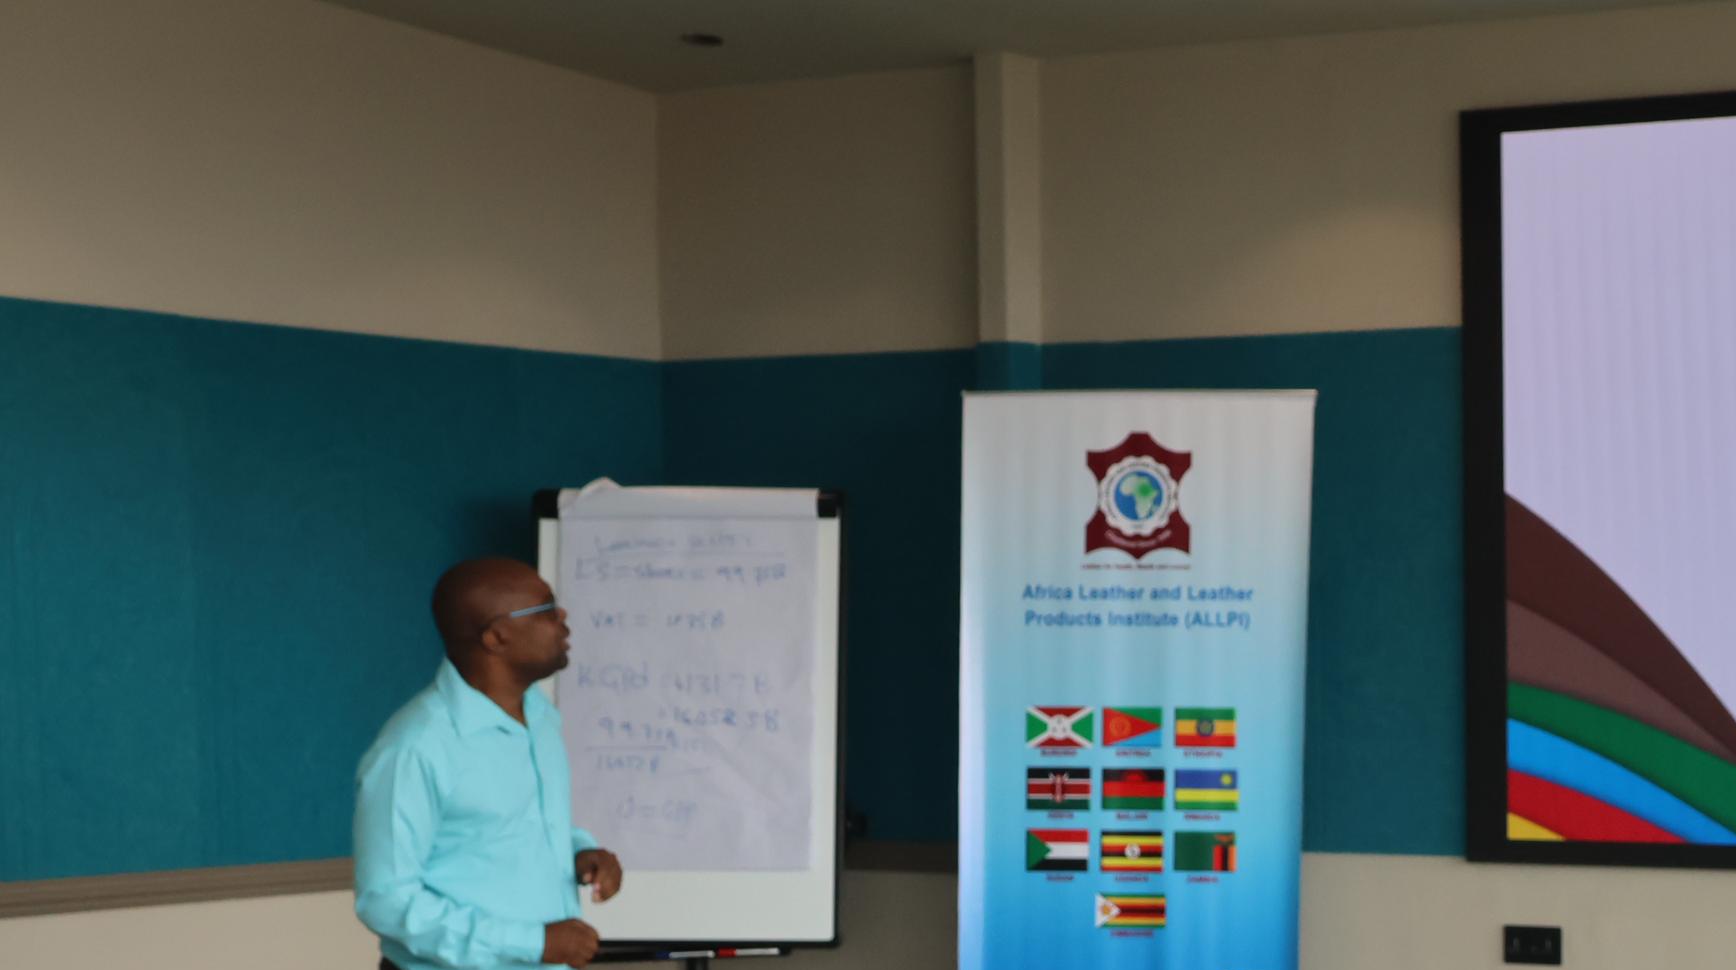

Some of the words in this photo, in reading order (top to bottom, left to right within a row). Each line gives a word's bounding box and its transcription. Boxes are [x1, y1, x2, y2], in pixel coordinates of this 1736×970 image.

[1023, 585, 1072, 599] Africa
[1079, 586, 1144, 600] Leather
[1150, 586, 1180, 599] and
[1187, 586, 1253, 600] Leather
[1025, 611, 1101, 626] Products
[1109, 612, 1178, 626] Institute
[1185, 611, 1250, 629] (ALLPI)
